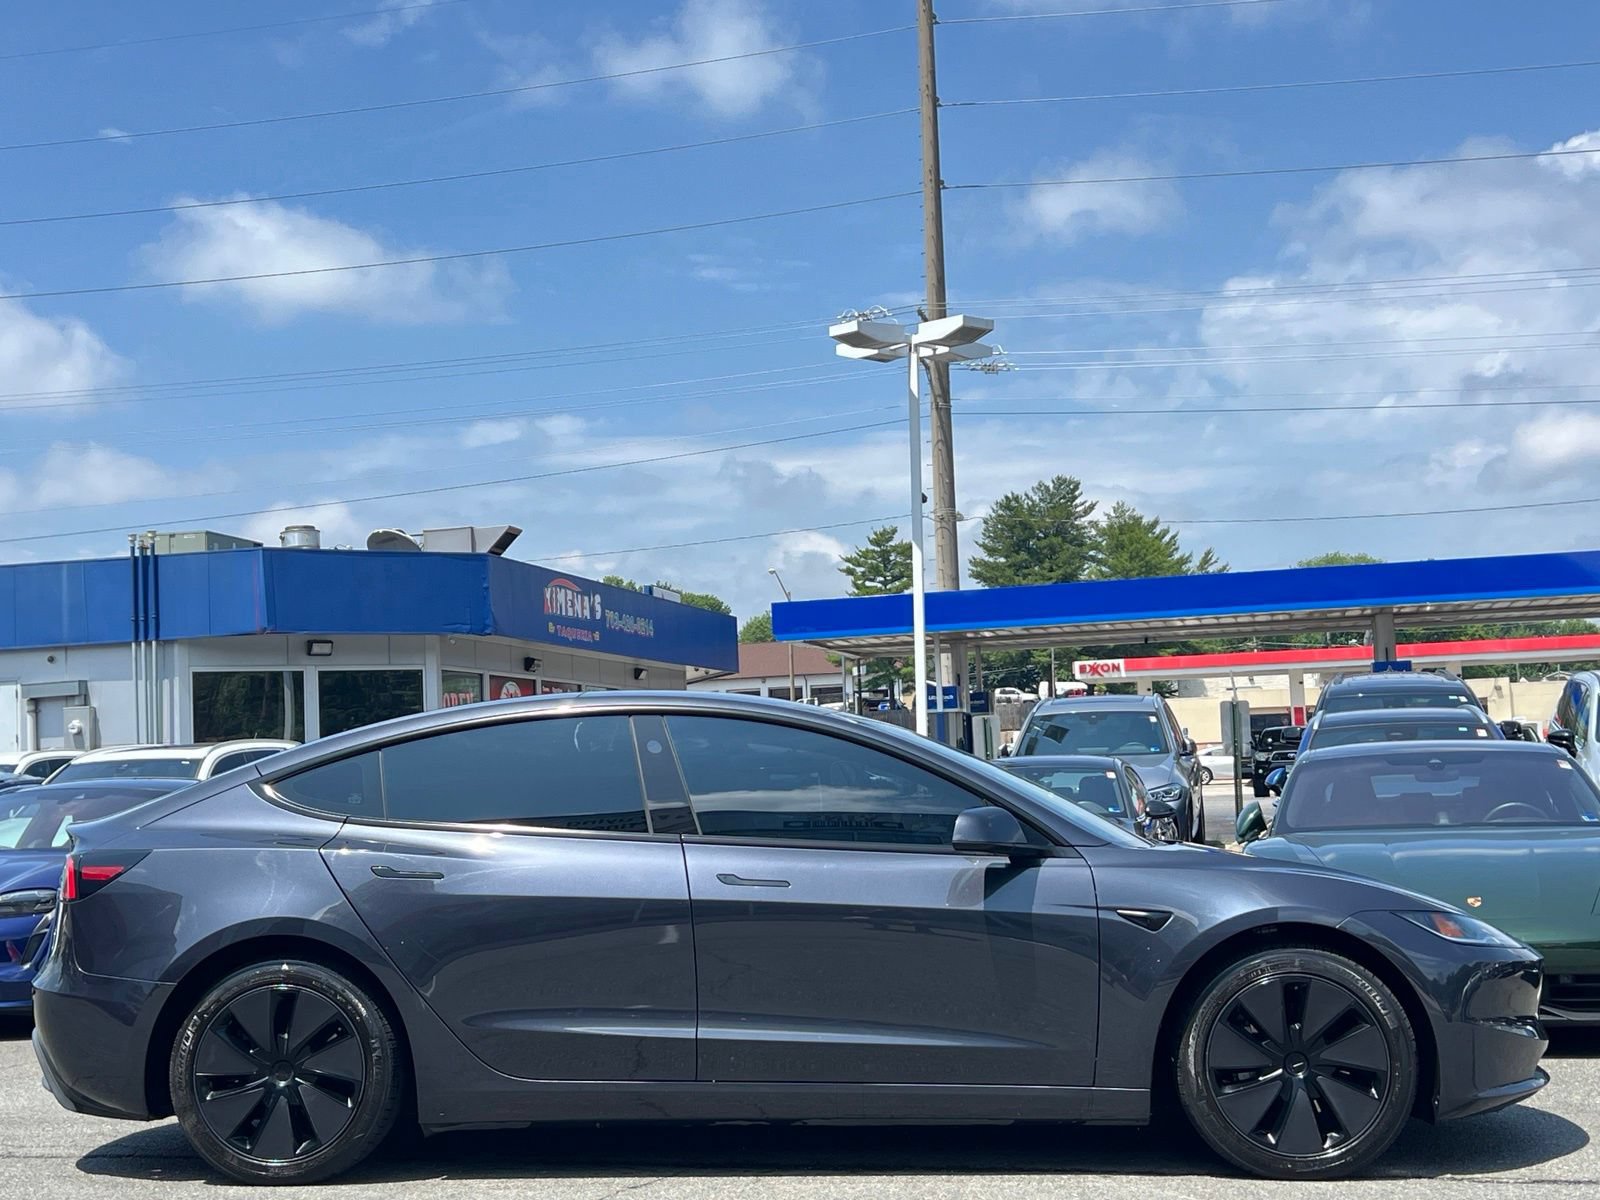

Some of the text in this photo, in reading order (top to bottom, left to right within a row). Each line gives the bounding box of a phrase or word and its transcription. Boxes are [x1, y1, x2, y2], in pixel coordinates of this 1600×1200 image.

[544, 587, 602, 620] XIMENA'S
[556, 625, 593, 642] TAQUERIA
[1079, 662, 1121, 677] EXXON
